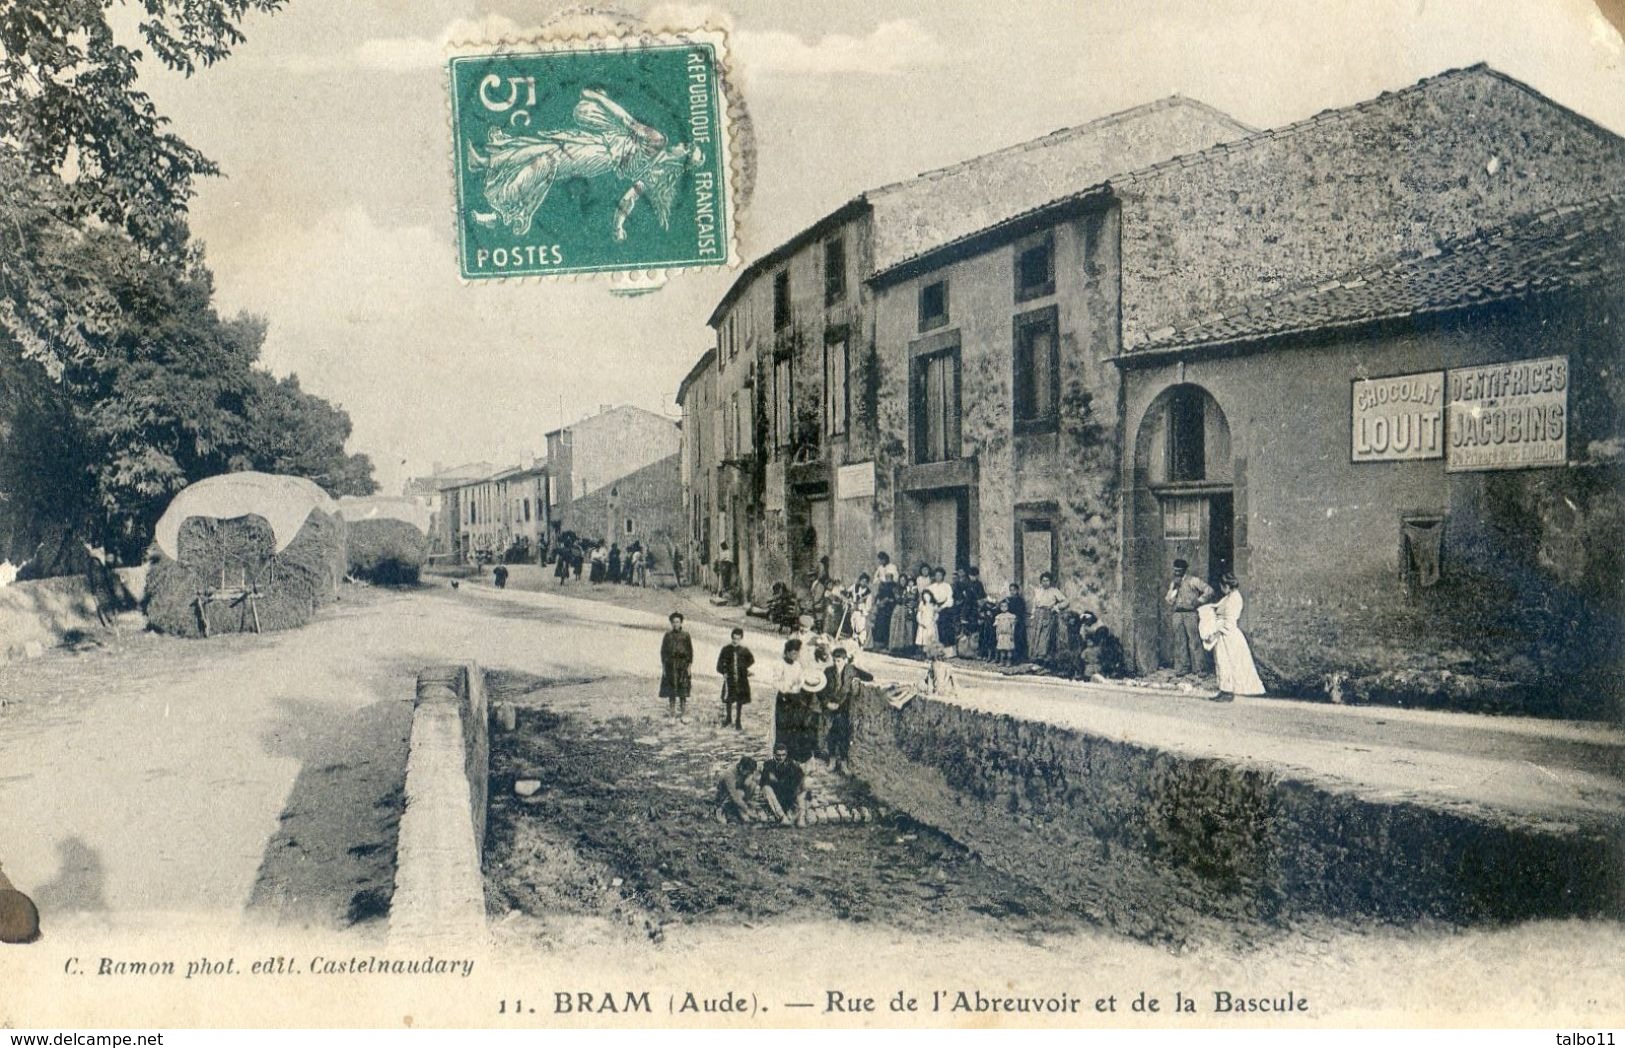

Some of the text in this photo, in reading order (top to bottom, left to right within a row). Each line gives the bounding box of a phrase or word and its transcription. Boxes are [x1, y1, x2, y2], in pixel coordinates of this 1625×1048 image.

[477, 245, 564, 268] POSTES
[1358, 382, 1440, 412] CHOCOLAT
[1451, 363, 1567, 402] DENTIFRICES
[1357, 412, 1441, 454] LOUIT
[1451, 404, 1565, 448] JACOBINS
[64, 957, 83, 975] C.
[98, 957, 175, 975] Ramon
[185, 957, 241, 979] phot.
[309, 955, 475, 977] Castelnaudary
[553, 991, 653, 1014] BRAM
[668, 991, 769, 1017] (Aude).
[826, 990, 875, 1013] Rue
[889, 990, 919, 1013] de
[932, 990, 1081, 1013] l'Abreuvoir
[1094, 994, 1118, 1013] et
[1131, 990, 1161, 1013] de
[1175, 991, 1198, 1013] la
[1213, 990, 1309, 1013] Bascule
